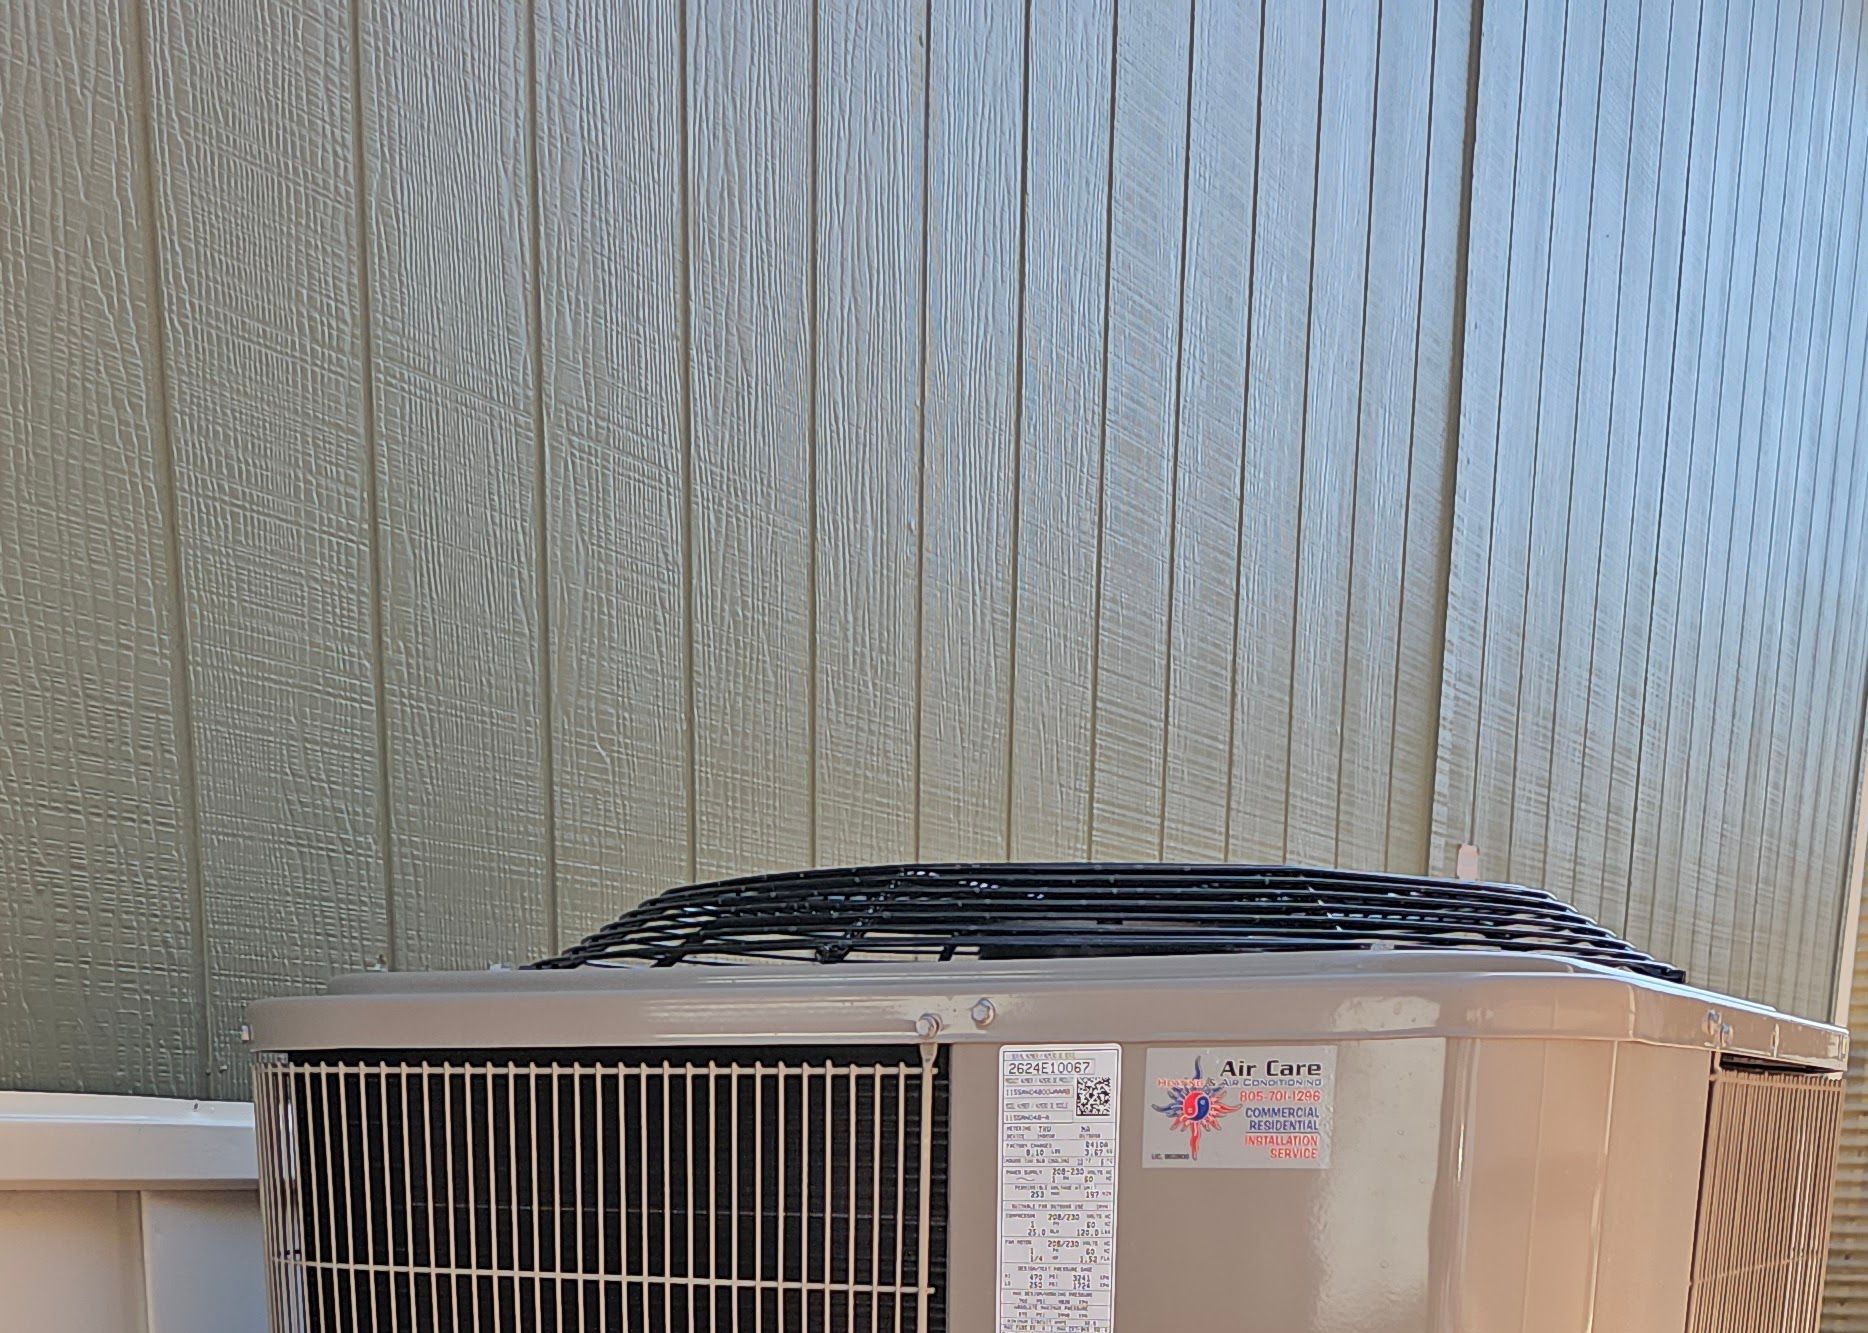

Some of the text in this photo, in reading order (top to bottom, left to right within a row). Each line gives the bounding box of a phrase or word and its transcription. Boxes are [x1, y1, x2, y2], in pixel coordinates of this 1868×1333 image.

[1008, 1062, 1090, 1074] 2624E10067
[1220, 1060, 1322, 1076] Air Care
[1209, 1078, 1215, 1086] &
[1222, 1079, 1239, 1087] AIR
[1243, 1078, 1322, 1087] CONDITIONING
[1240, 1090, 1320, 1102] 805-701-1296
[1246, 1107, 1319, 1118] COMMERCIAL
[1249, 1120, 1318, 1131] RESIDENTIAL
[1245, 1135, 1318, 1146] INSTALLATION
[1270, 1148, 1317, 1159] SERVICE
[1086, 1191, 1099, 1199] 197
